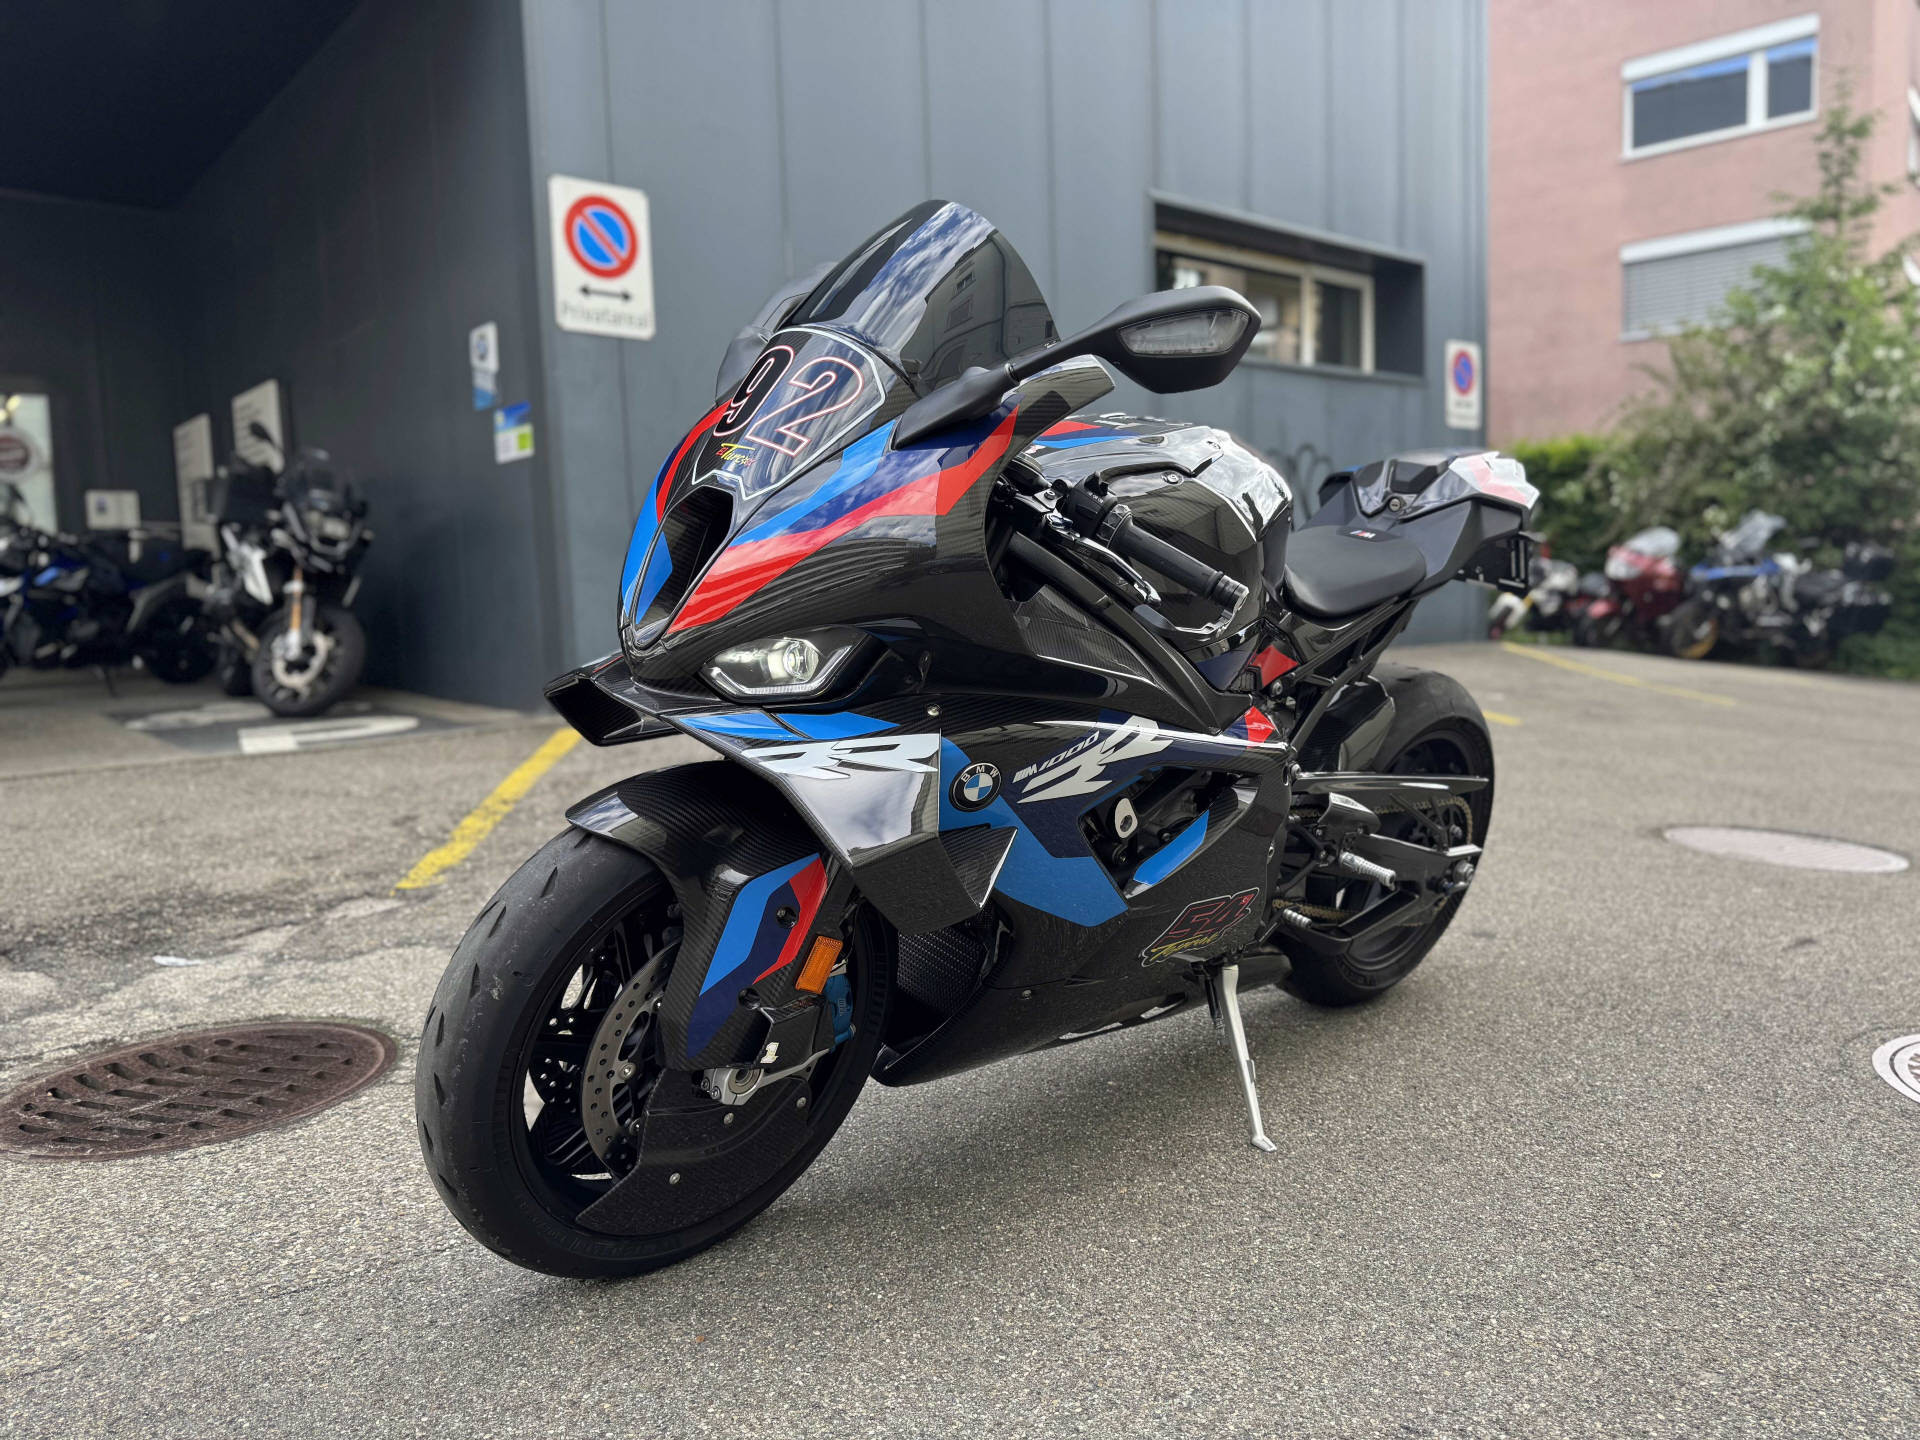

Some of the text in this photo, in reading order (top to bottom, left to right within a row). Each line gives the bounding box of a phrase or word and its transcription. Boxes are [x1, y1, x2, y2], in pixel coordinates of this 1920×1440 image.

[713, 345, 865, 457] 92
[960, 764, 1000, 783] BMW
[760, 1042, 780, 1064] 1
